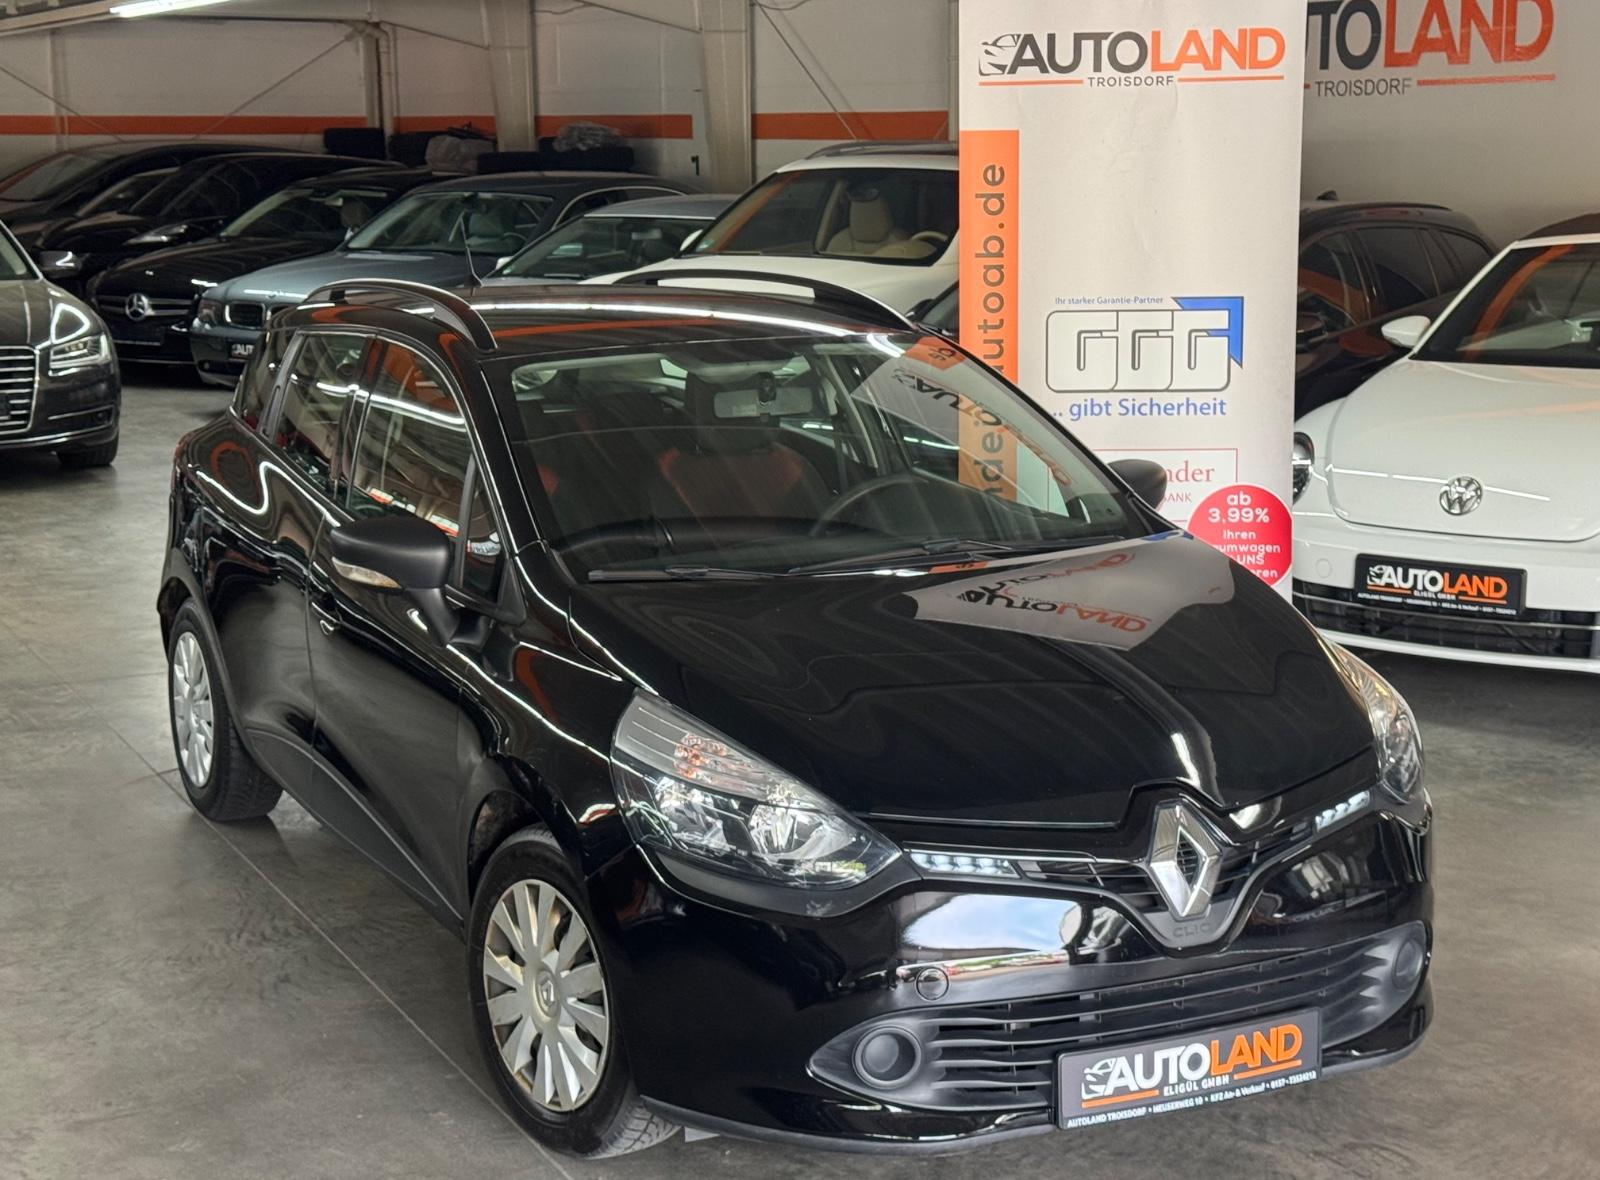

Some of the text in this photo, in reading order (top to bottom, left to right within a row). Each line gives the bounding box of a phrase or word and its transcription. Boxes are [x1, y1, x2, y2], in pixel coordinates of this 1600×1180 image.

[1306, 0, 1555, 70] TOLAND
[1007, 27, 1286, 75] AUTOLAND
[1087, 75, 1175, 88] TROISDORF
[1315, 78, 1412, 98] TROISDORF
[1068, 296, 1095, 305] starker
[1097, 296, 1163, 305] Garantie-Partner
[1069, 398, 1112, 421] gibt
[1118, 397, 1227, 416] Sicherheit
[1226, 491, 1252, 506] ab
[1223, 529, 1256, 540] Ihren
[1380, 565, 1508, 599] AUTOLAND
[1172, 922, 1212, 939] CLIO
[1103, 1023, 1303, 1097] AUTOLAND
[1163, 1074, 1230, 1097] ELIGÜL GMBH
[1067, 1111, 1107, 1128] AUTOLAND
[1107, 1106, 1147, 1122] TROISDORF
